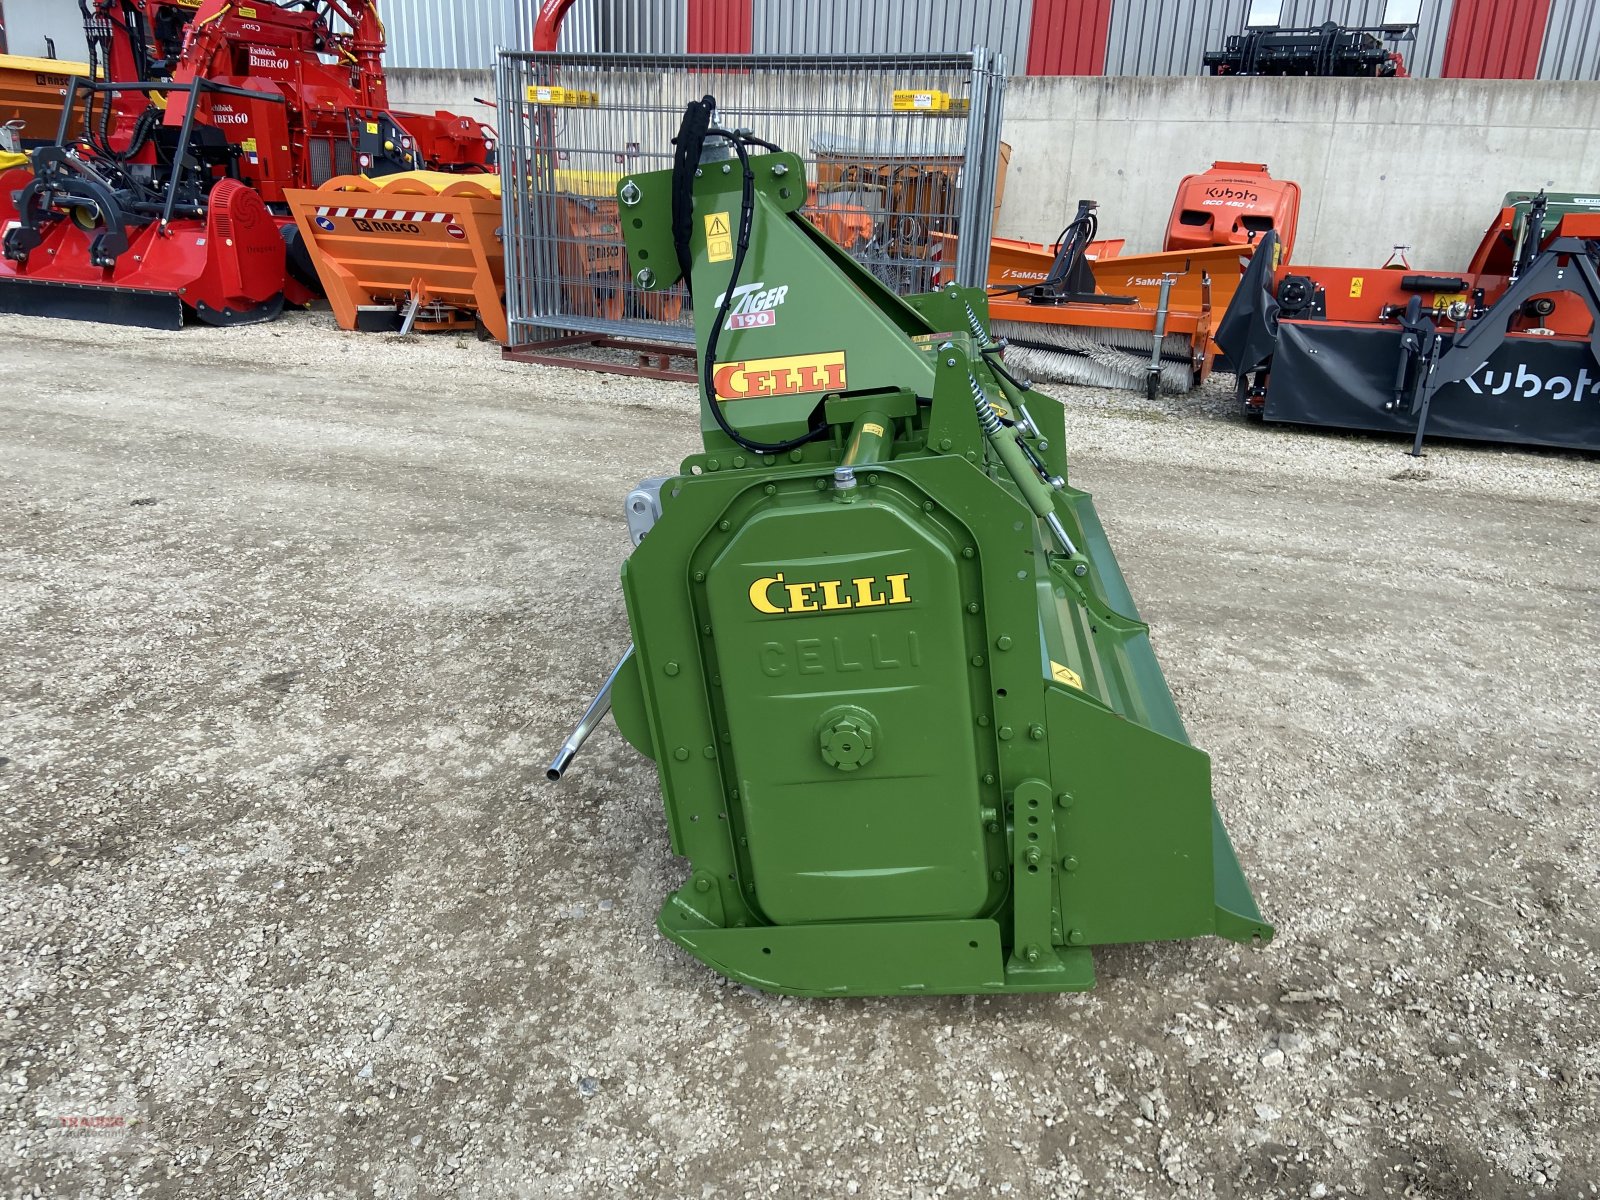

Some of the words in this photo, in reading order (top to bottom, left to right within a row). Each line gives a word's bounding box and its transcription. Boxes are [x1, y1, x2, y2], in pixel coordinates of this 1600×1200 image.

[214, 112, 249, 124] IBER60
[1205, 187, 1258, 202] Kubota
[371, 221, 420, 234] RASCO
[714, 282, 789, 330] TIGER
[736, 312, 770, 327] 190
[713, 363, 846, 399] CELLI
[748, 572, 912, 614] CELLI
[759, 631, 920, 678] CELLI
